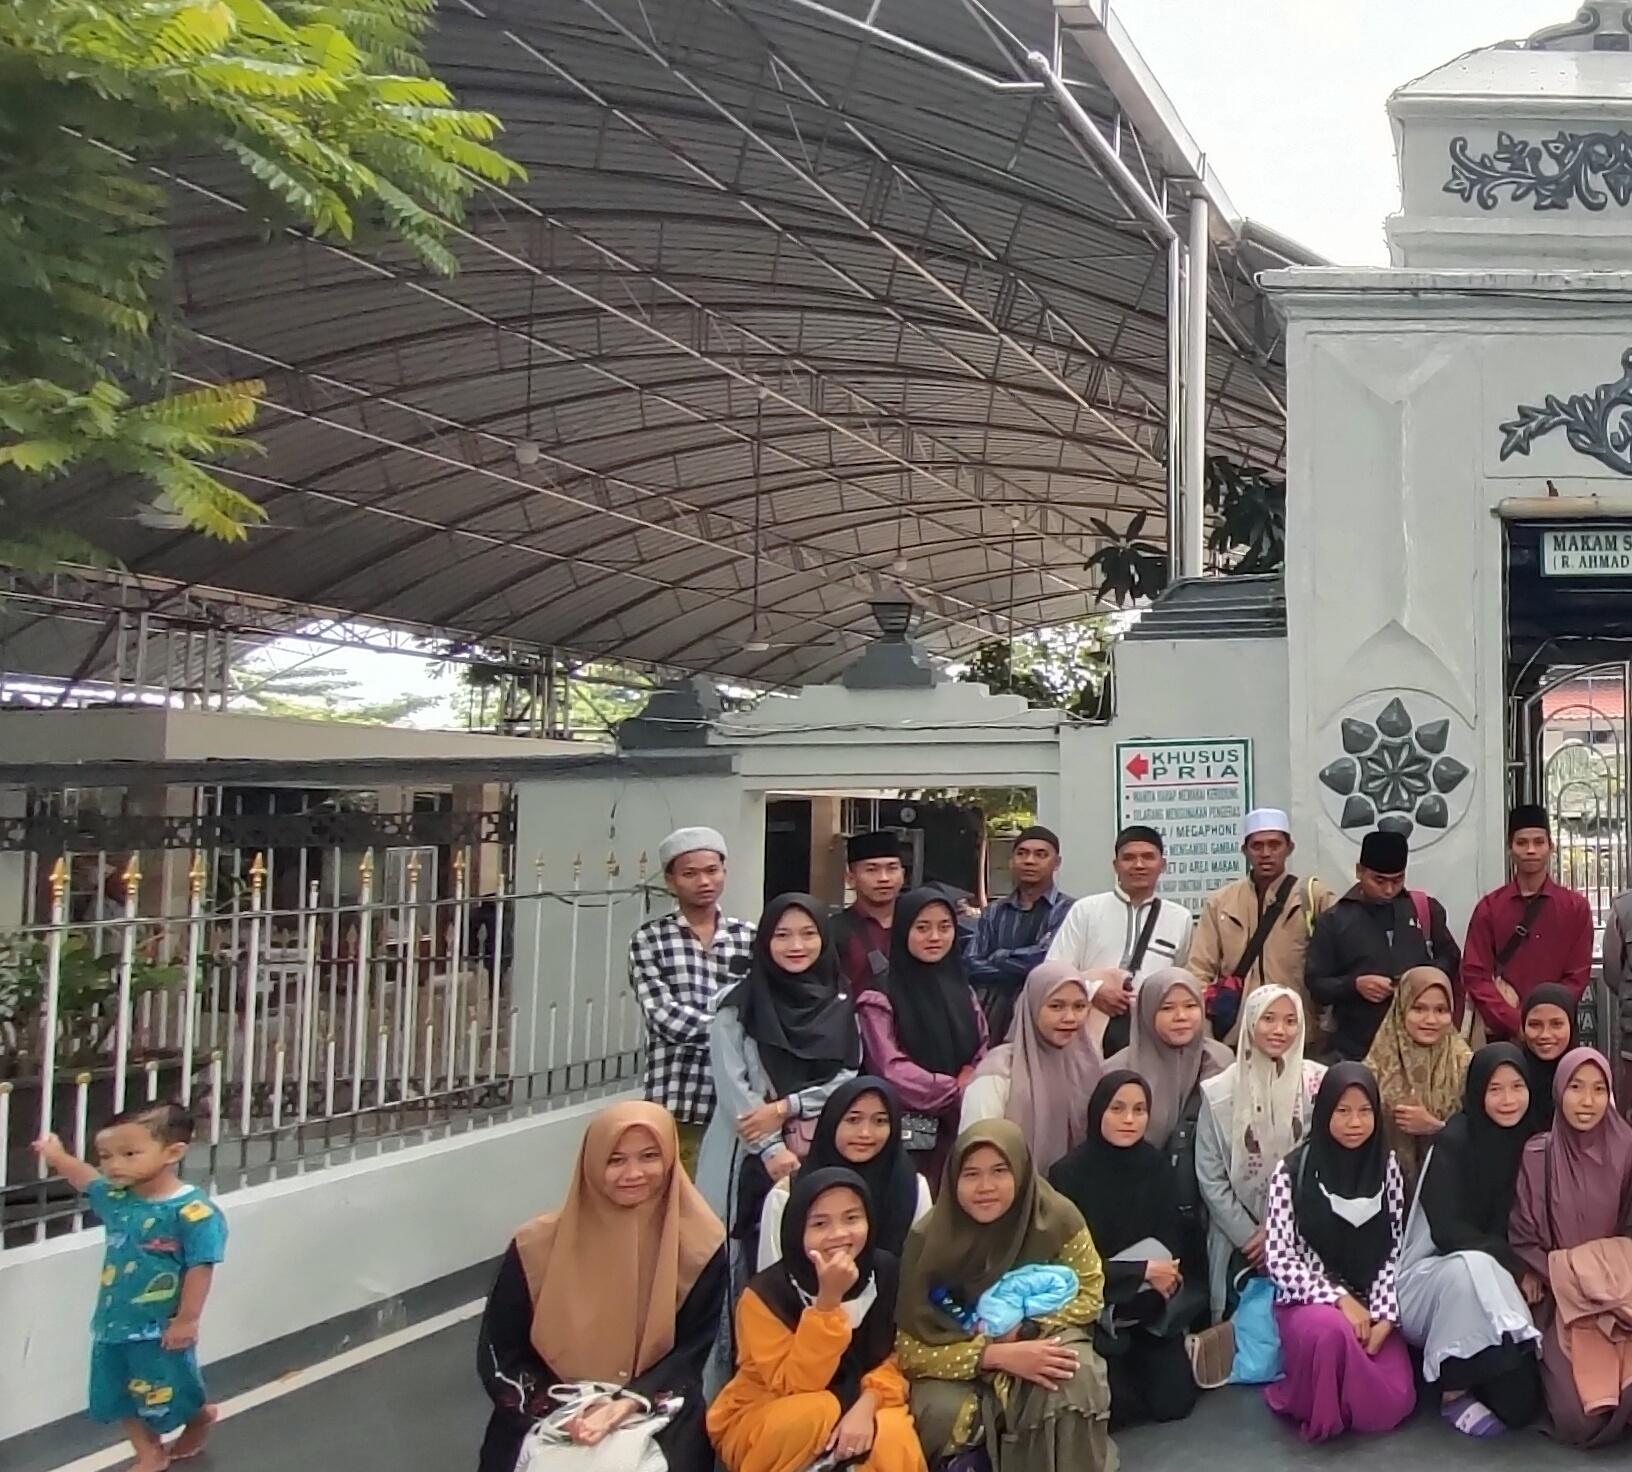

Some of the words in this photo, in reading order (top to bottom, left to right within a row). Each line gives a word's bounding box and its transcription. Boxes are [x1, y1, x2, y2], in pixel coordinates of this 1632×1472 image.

[1553, 534, 1617, 551] MAKAM
[1579, 554, 1630, 569] AHMAD
[1152, 749, 1239, 765] KHUSUS
[1153, 764, 1239, 780] PRIA
